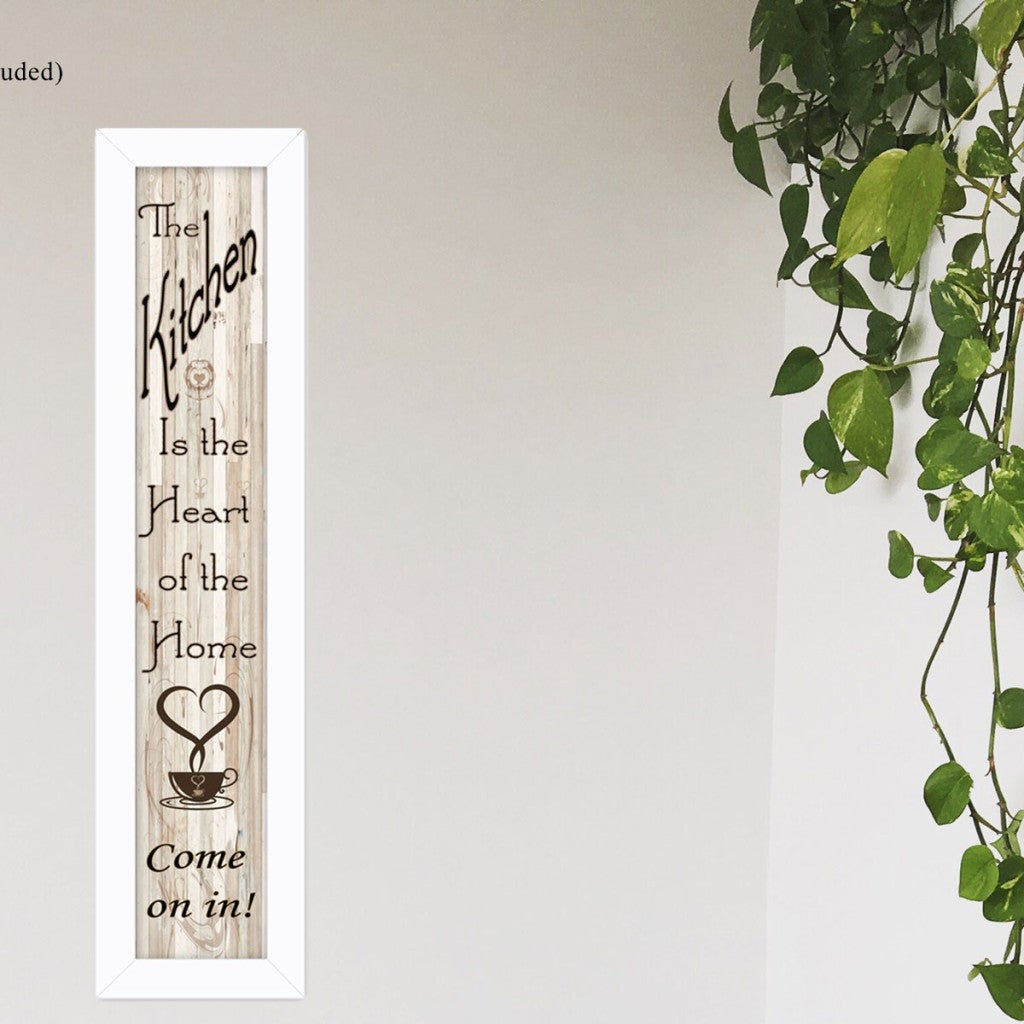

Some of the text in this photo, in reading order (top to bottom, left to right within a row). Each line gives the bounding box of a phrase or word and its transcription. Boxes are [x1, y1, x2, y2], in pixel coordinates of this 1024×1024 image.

[137, 202, 199, 238] The
[141, 209, 257, 411] Kitchen
[159, 417, 248, 456] Is the
[138, 484, 250, 538] Heart
[158, 552, 248, 592] of the
[141, 620, 257, 674] Home
[146, 843, 246, 873] Come
[146, 891, 256, 919] on in!
